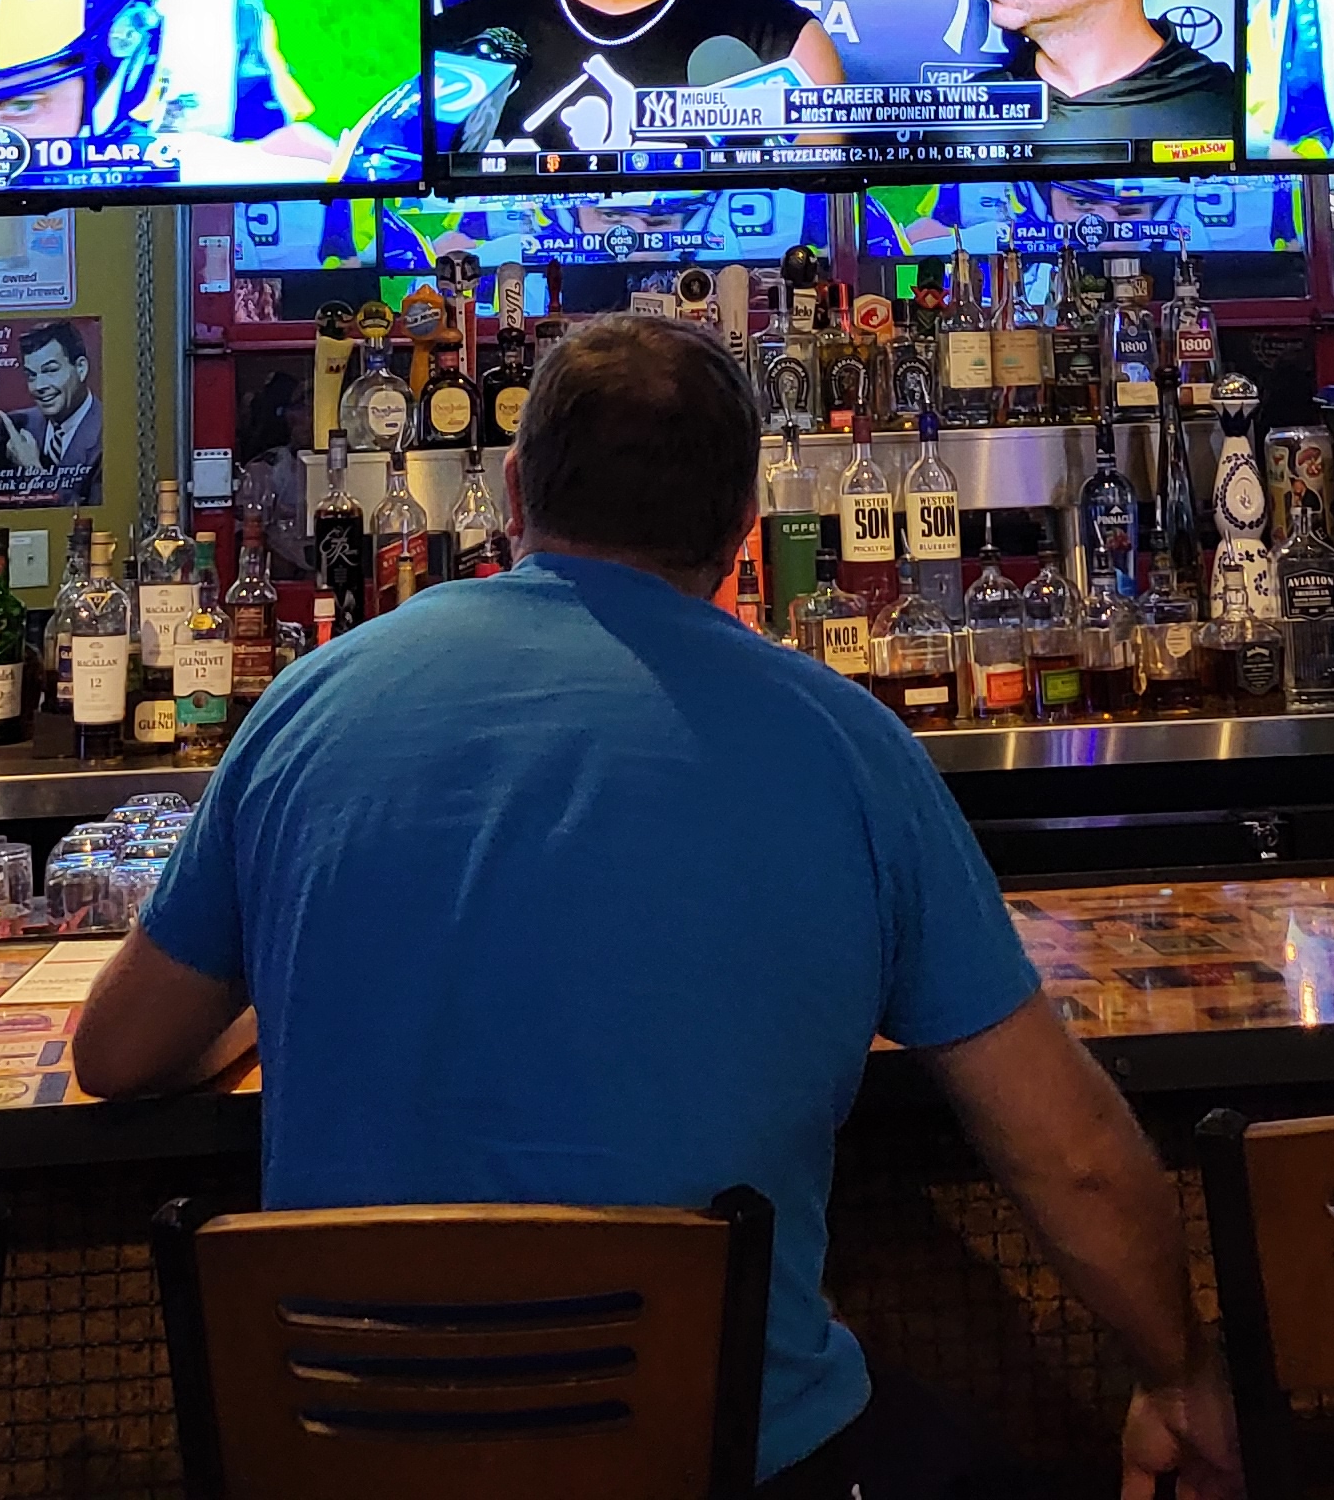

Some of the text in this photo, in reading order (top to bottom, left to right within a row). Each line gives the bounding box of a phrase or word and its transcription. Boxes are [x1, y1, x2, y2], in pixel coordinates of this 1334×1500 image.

[681, 92, 725, 106] MIGUEL
[790, 89, 818, 105] 4TH
[822, 89, 885, 105] CAREER
[889, 88, 911, 104] HR
[937, 87, 988, 102] TWINS
[681, 105, 762, 127] ANDÚJAR
[801, 108, 833, 122] MOST
[850, 107, 873, 120] ANY
[876, 106, 935, 120] OPPONENT
[938, 106, 962, 119] NOT
[964, 106, 976, 119] IN
[979, 105, 999, 119] A.L.
[1003, 104, 1030, 118] EAST
[34, 141, 72, 167] 10
[87, 144, 140, 161] LAR
[673, 153, 684, 169] 4
[736, 151, 762, 163] WIN
[772, 149, 847, 163] STRZELECKI:
[850, 148, 884, 163] (2-1),
[886, 148, 895, 161] 2
[898, 147, 914, 162] IP,
[929, 147, 942, 161] H,
[1013, 145, 1022, 158] 2
[1024, 145, 1034, 158] K
[589, 156, 598, 171] 2
[68, 171, 122, 184] 1st & 10
[2, 272, 37, 284] owned
[26, 284, 65, 298] brewed
[506, 281, 522, 329] Wre
[794, 303, 813, 318] delo
[1120, 340, 1148, 354] 1800
[1180, 335, 1212, 352] 1800
[15, 465, 23, 477] I
[57, 464, 92, 479] prefer
[19, 481, 27, 491] a
[46, 477, 58, 492] of
[854, 497, 890, 540] WESTERN SON
[920, 495, 956, 538] WESTERN SON
[1287, 576, 1334, 588] AVIATION
[145, 605, 185, 614] MACALLAN
[159, 624, 171, 634] 18
[825, 626, 858, 647] KNOB
[831, 644, 865, 654] CREEK
[76, 658, 118, 668] MACALLAN
[178, 656, 224, 667] GLENLIVET
[194, 667, 207, 679] 12
[90, 677, 102, 689] 12
